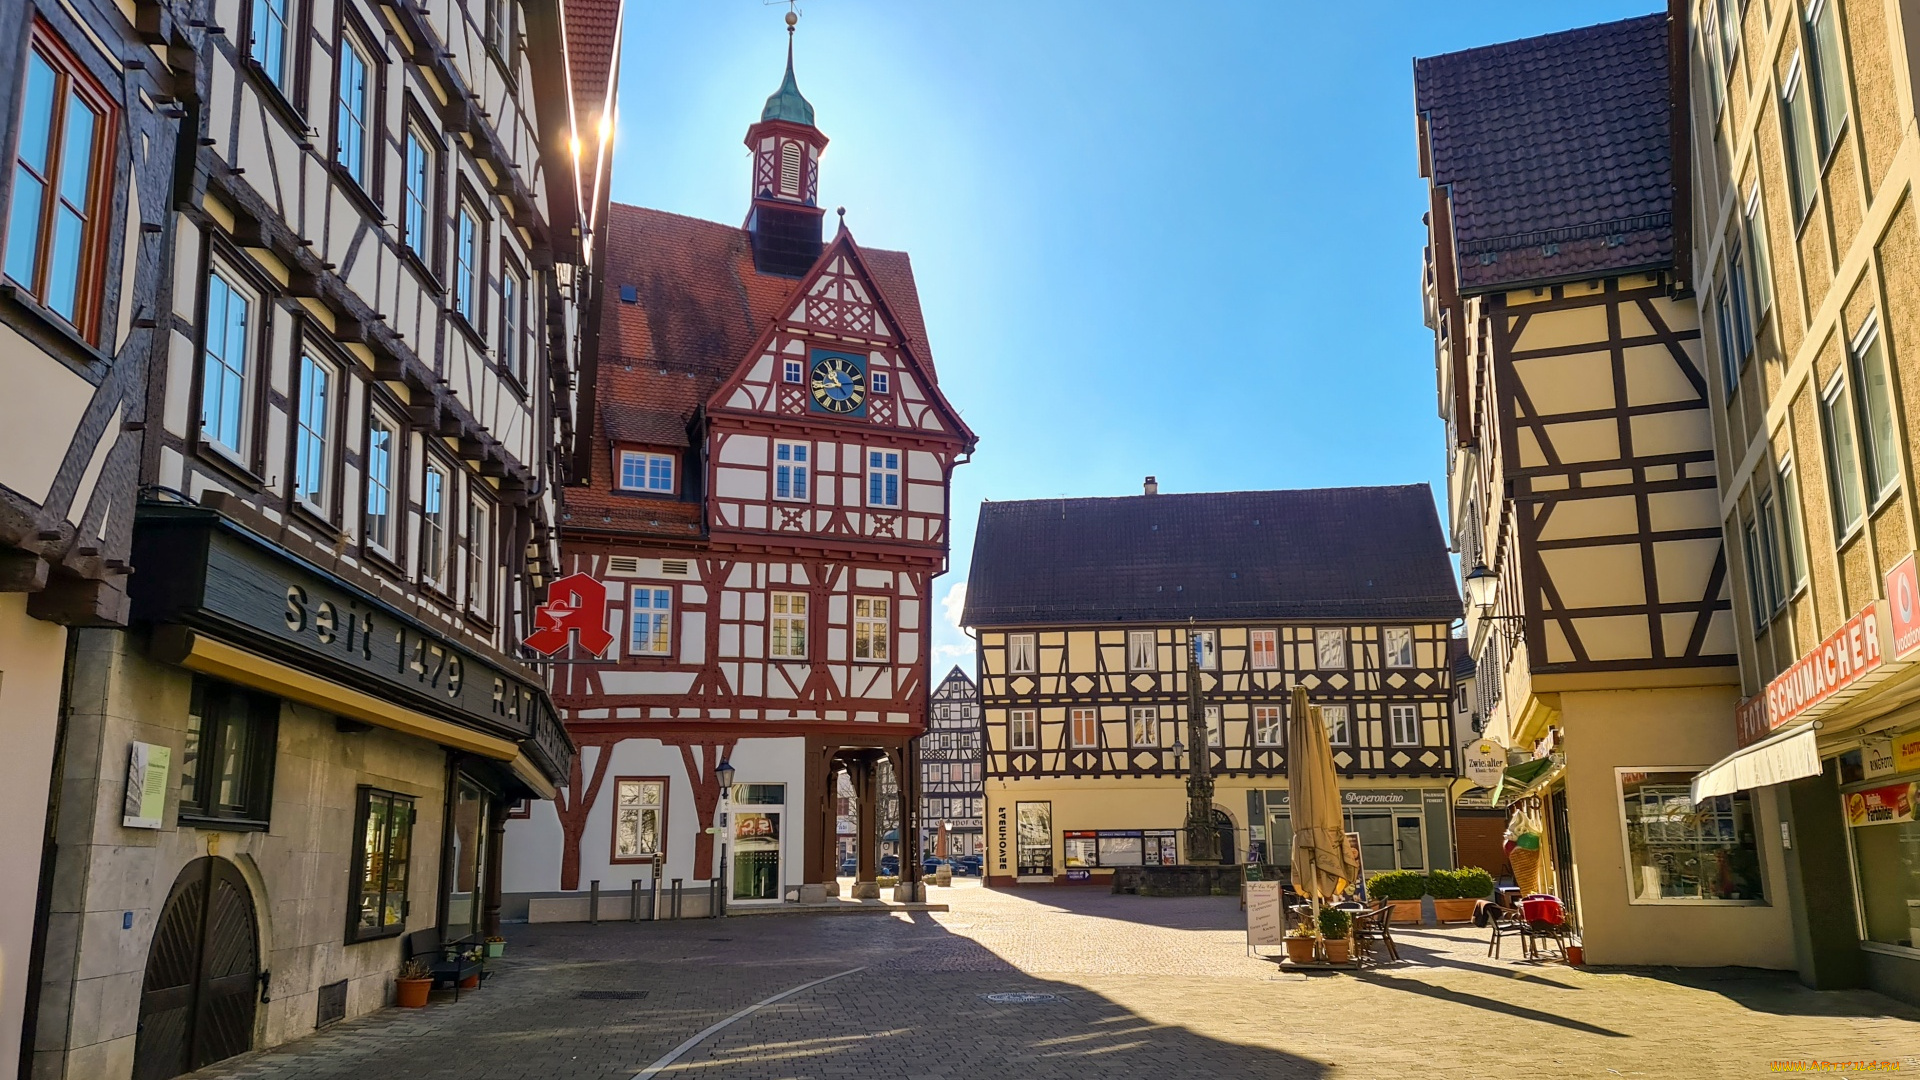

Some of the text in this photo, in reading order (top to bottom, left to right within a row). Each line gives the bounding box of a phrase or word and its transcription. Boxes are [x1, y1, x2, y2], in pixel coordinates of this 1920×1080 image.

[395, 628, 465, 699] 1479
[1743, 613, 1881, 739] FOTO SCHUMACHER
[1469, 758, 1503, 768] Zwiealter
[1345, 792, 1404, 805] Peperoncino
[998, 807, 1007, 869] BEWOHNBAR
